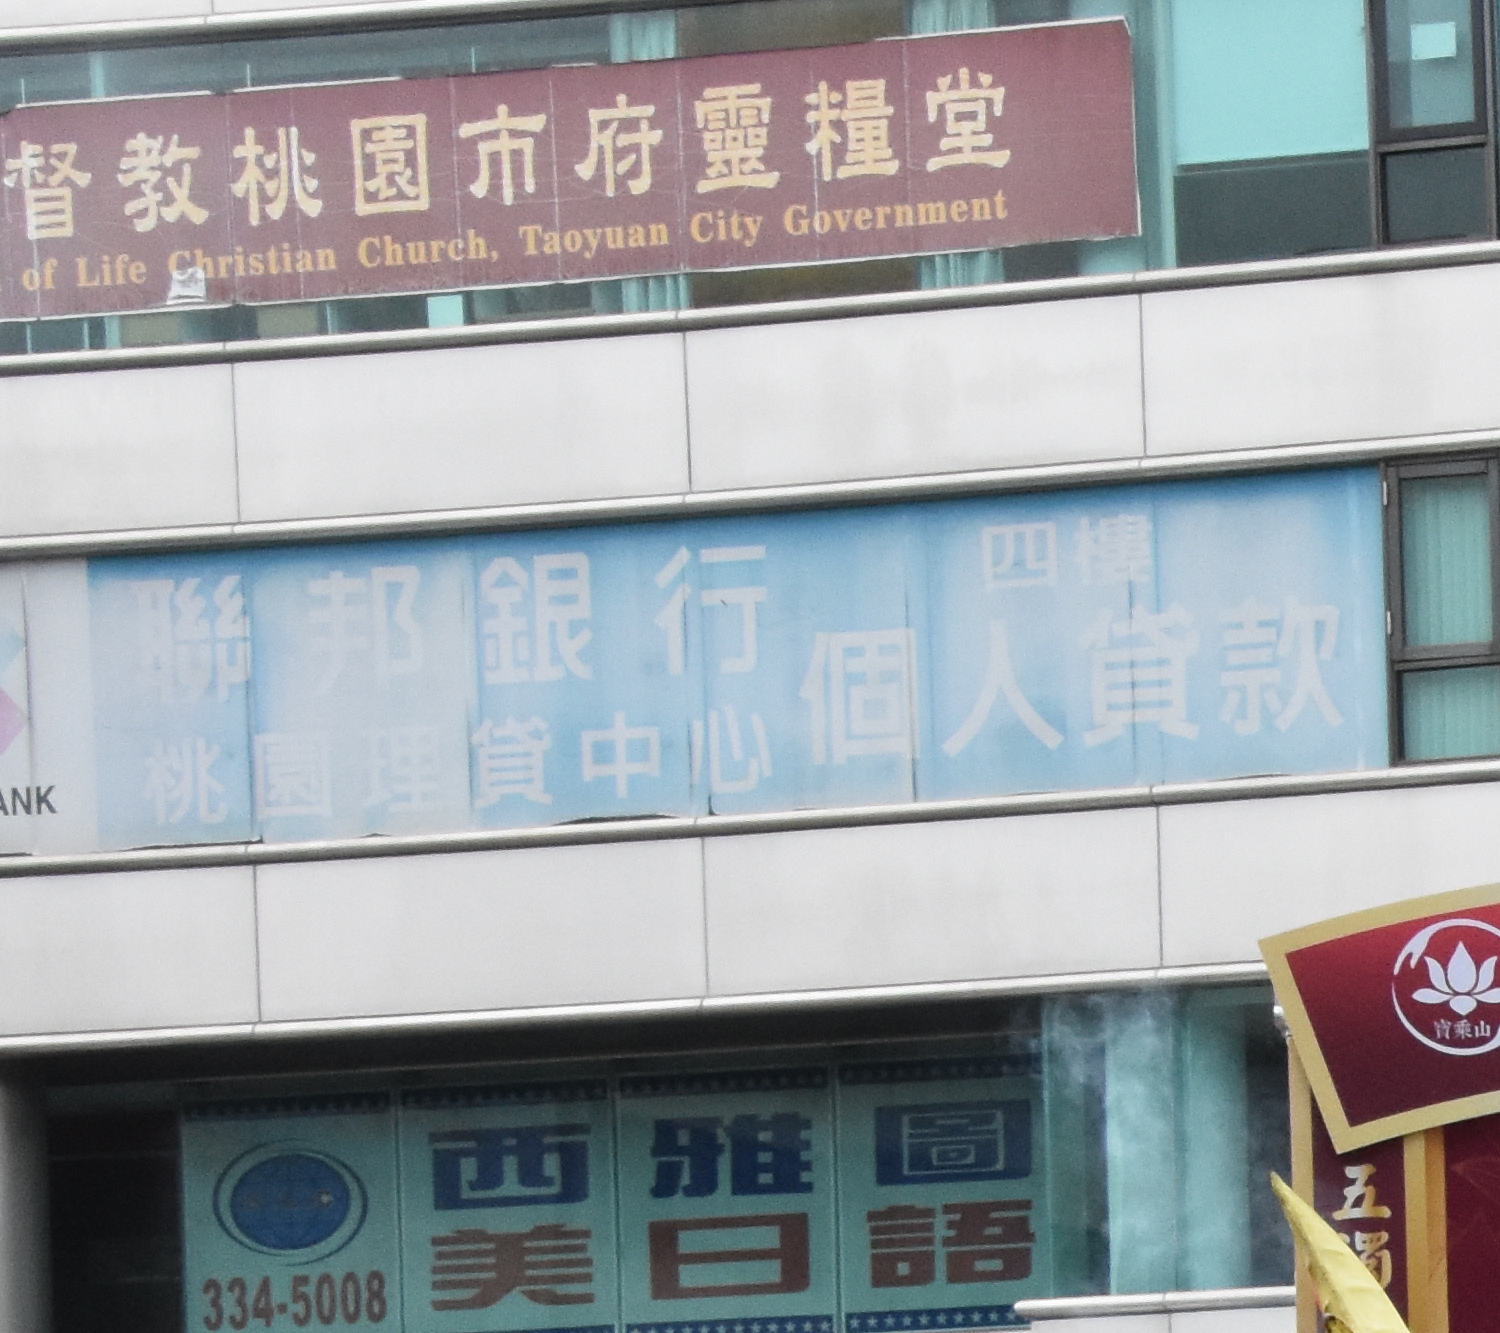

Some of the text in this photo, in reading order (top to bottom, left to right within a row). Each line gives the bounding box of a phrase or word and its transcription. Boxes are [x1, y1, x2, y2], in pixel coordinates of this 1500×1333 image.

[22, 189, 1009, 291] of Life Christian Church, Taoyuan City Government
[977, 512, 1155, 592] 四樓
[134, 543, 772, 706] 聯邦銀行
[801, 598, 1346, 769] 個人貸款
[427, 1098, 1033, 1212] 西雅圖
[200, 1270, 388, 1332] 334-5008
[429, 1199, 1036, 1312] 美日語
